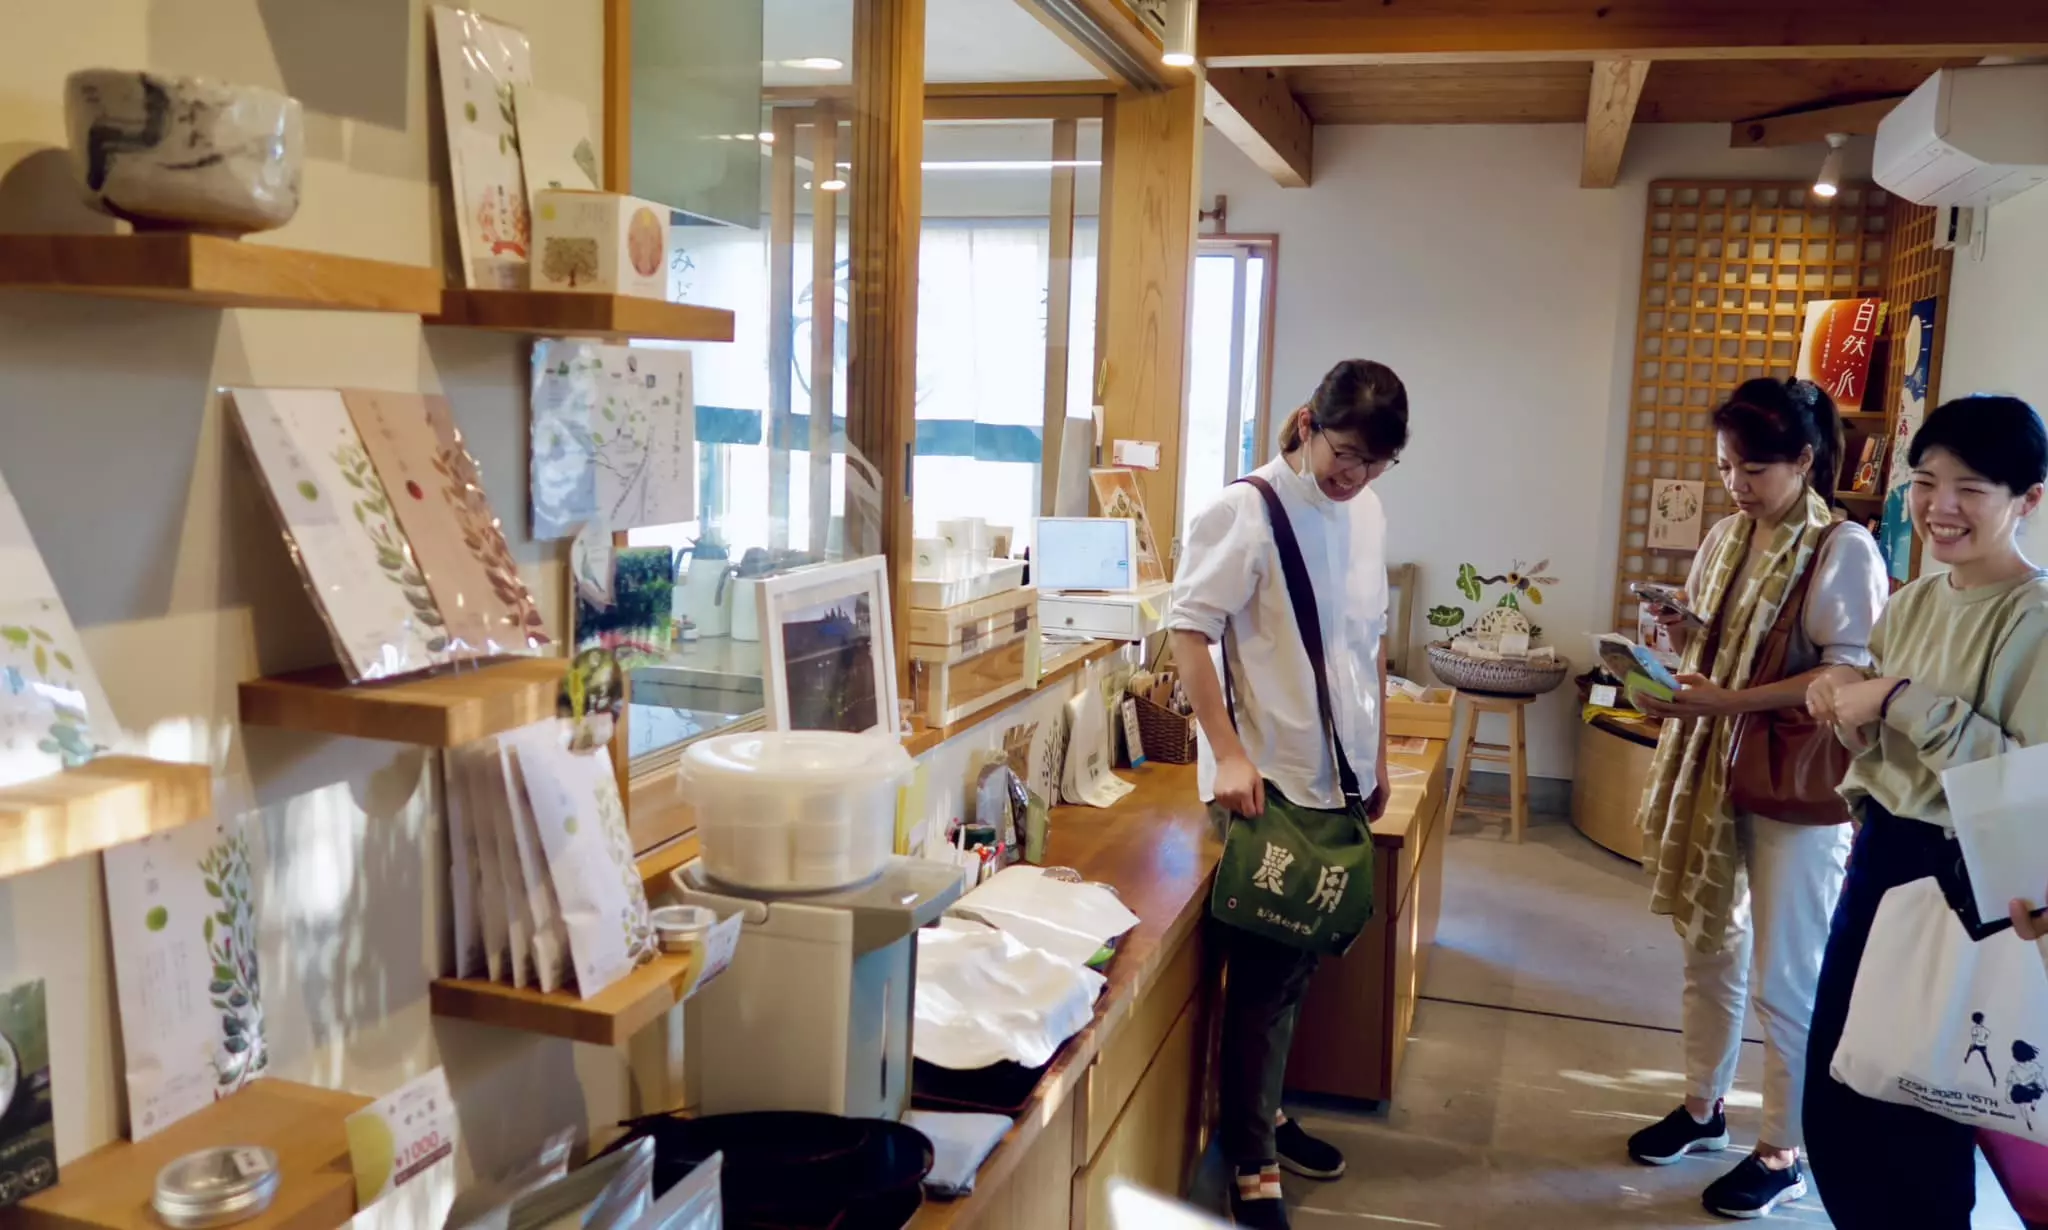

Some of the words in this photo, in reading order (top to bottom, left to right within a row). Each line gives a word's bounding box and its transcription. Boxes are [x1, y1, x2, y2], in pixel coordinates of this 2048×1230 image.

[1823, 298, 1875, 397] 自然派
[1931, 1088, 1962, 1100] 2020
[1966, 1093, 1999, 1108] 45TH
